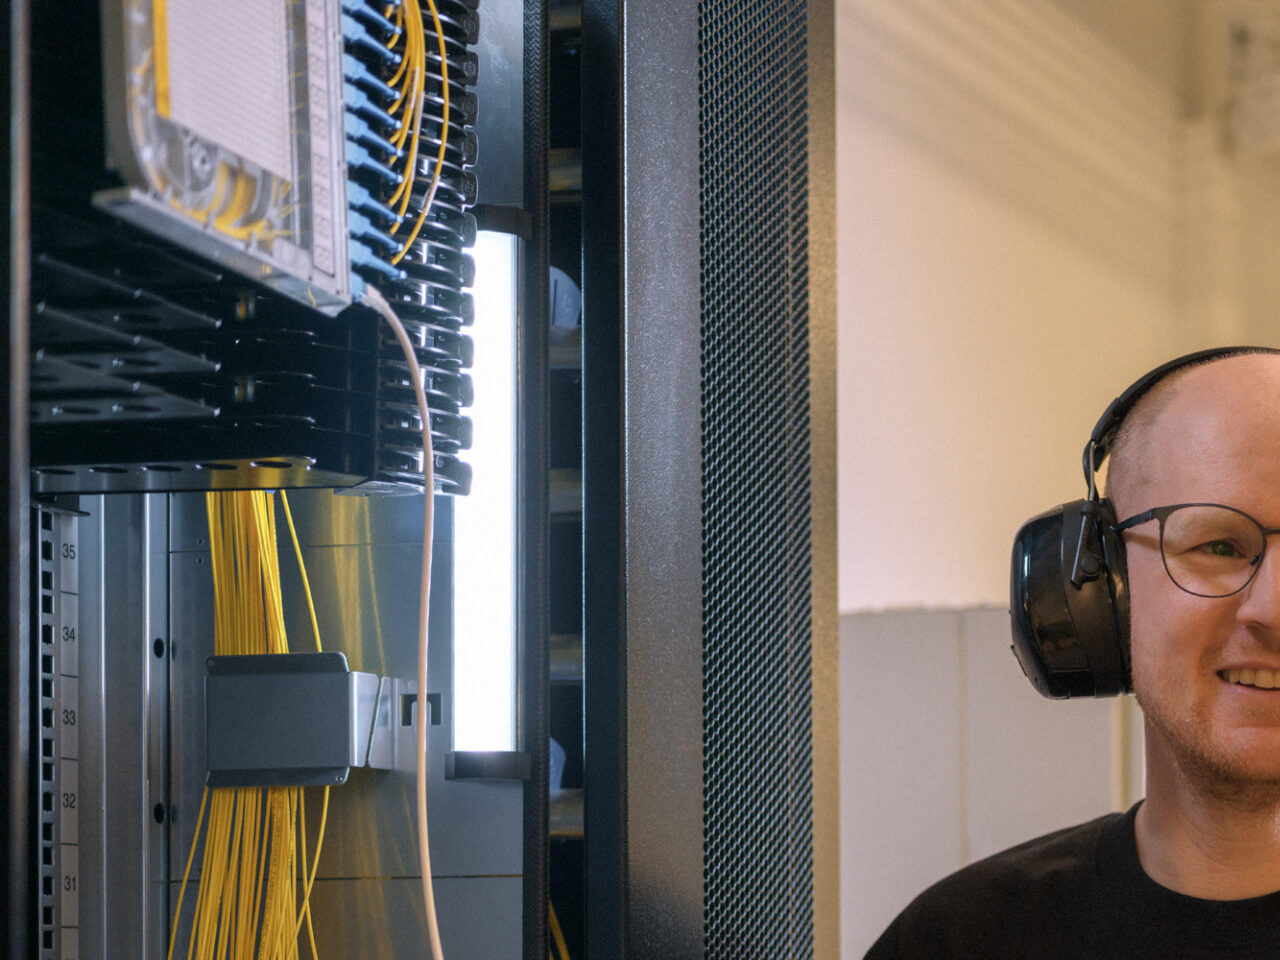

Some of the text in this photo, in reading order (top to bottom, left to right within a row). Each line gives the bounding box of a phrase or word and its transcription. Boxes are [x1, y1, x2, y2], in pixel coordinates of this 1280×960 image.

[62, 543, 76, 560] 35
[62, 626, 76, 642] 34
[62, 709, 76, 726] 33
[62, 792, 76, 809] 32
[64, 876, 76, 891] 31
